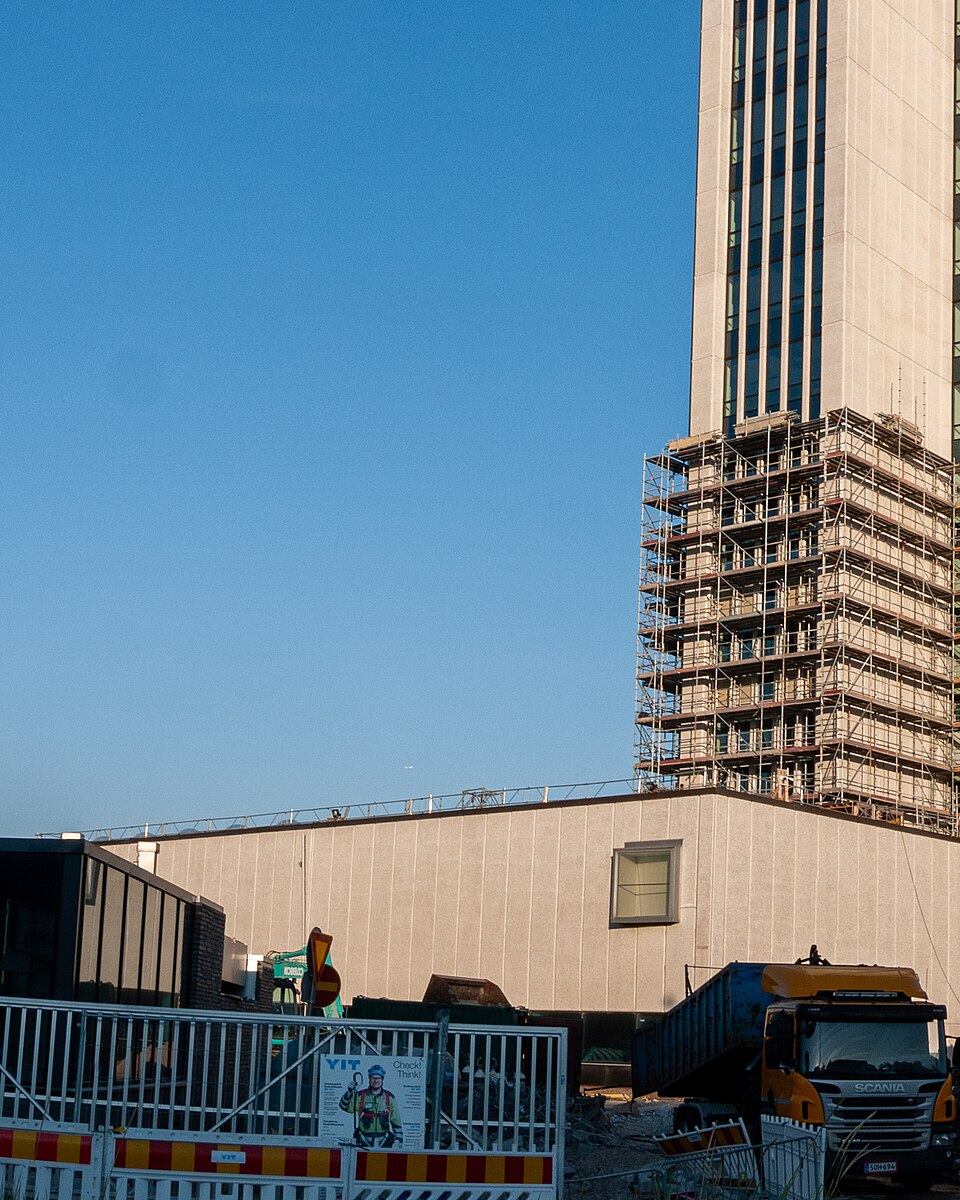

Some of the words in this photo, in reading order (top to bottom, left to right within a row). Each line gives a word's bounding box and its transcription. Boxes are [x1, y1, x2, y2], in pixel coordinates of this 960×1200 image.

[326, 1059, 360, 1070] YIT
[393, 1061, 422, 1069] Check!
[397, 1070, 422, 1079] Think!
[855, 1083, 905, 1093] SCANIA
